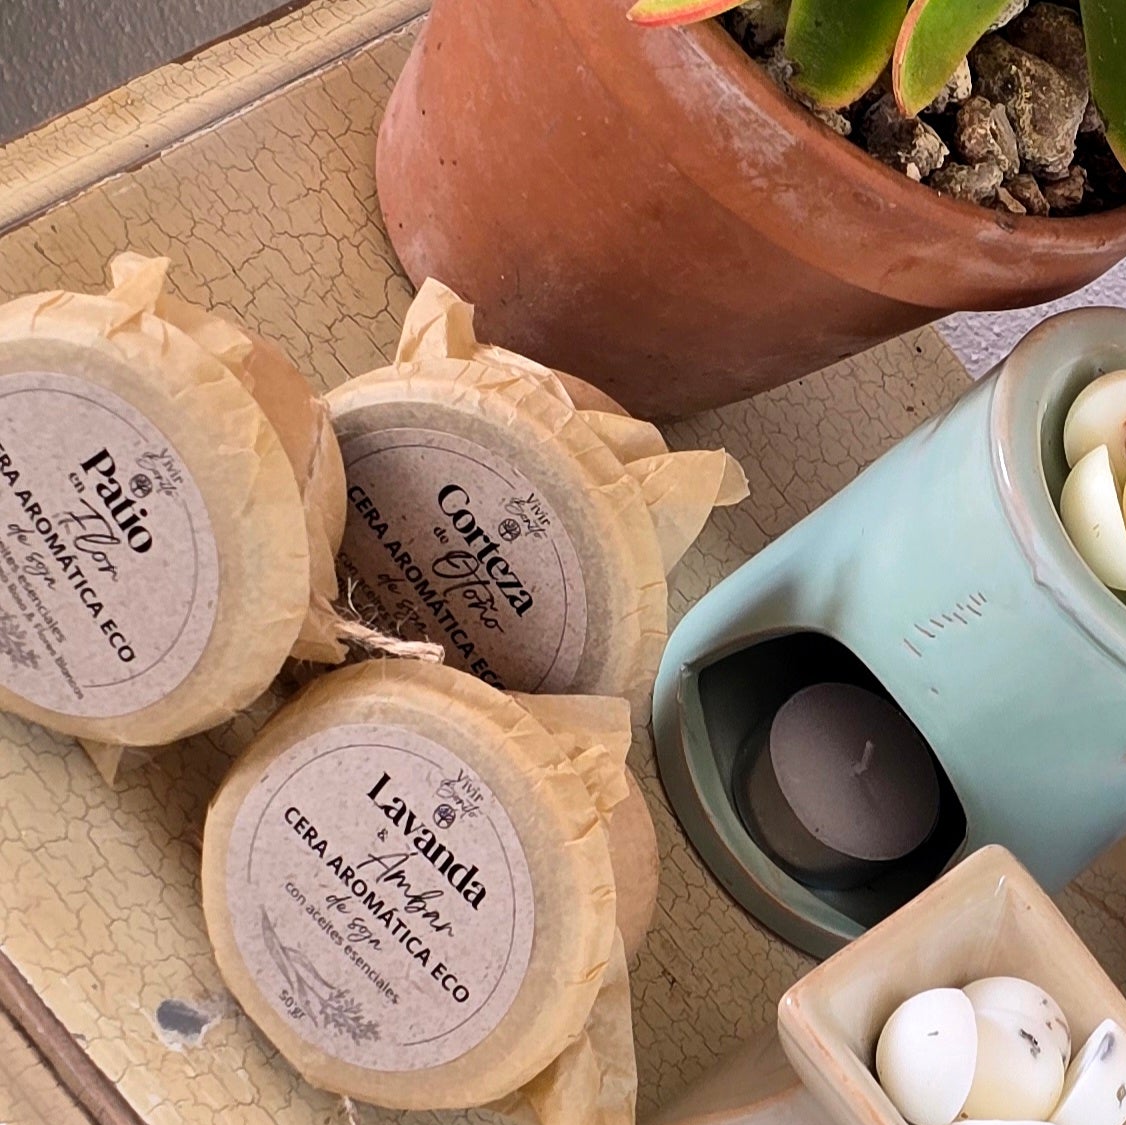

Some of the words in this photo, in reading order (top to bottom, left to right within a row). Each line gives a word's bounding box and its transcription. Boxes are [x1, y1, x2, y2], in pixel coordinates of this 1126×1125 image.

[68, 472, 86, 494] en
[79, 447, 153, 554] Patio
[154, 447, 184, 484] Vivir
[5, 522, 37, 549] de
[57, 497, 122, 582] Flor
[432, 525, 450, 547] de
[522, 492, 551, 526] Vivir
[0, 443, 20, 487] RA
[14, 490, 104, 619] AROMÁTICA
[99, 618, 136, 663] ECO
[347, 485, 389, 540] CERA
[383, 540, 477, 660] AROMÁTICA
[375, 572, 407, 597] de
[437, 484, 534, 619] Corteza
[17, 574, 65, 644] esenciales
[431, 550, 505, 633] Otoño
[451, 768, 484, 803] Vivir
[366, 771, 487, 911] Lavanda
[376, 827, 389, 843] &
[284, 806, 328, 859] CERA
[326, 855, 431, 968] AROMÁTICA
[430, 962, 470, 1003] ECO
[324, 893, 354, 916] de
[355, 837, 454, 937] Ámbar
[284, 881, 307, 906] con
[305, 904, 344, 946] aceites
[343, 944, 399, 1005] esenciales
